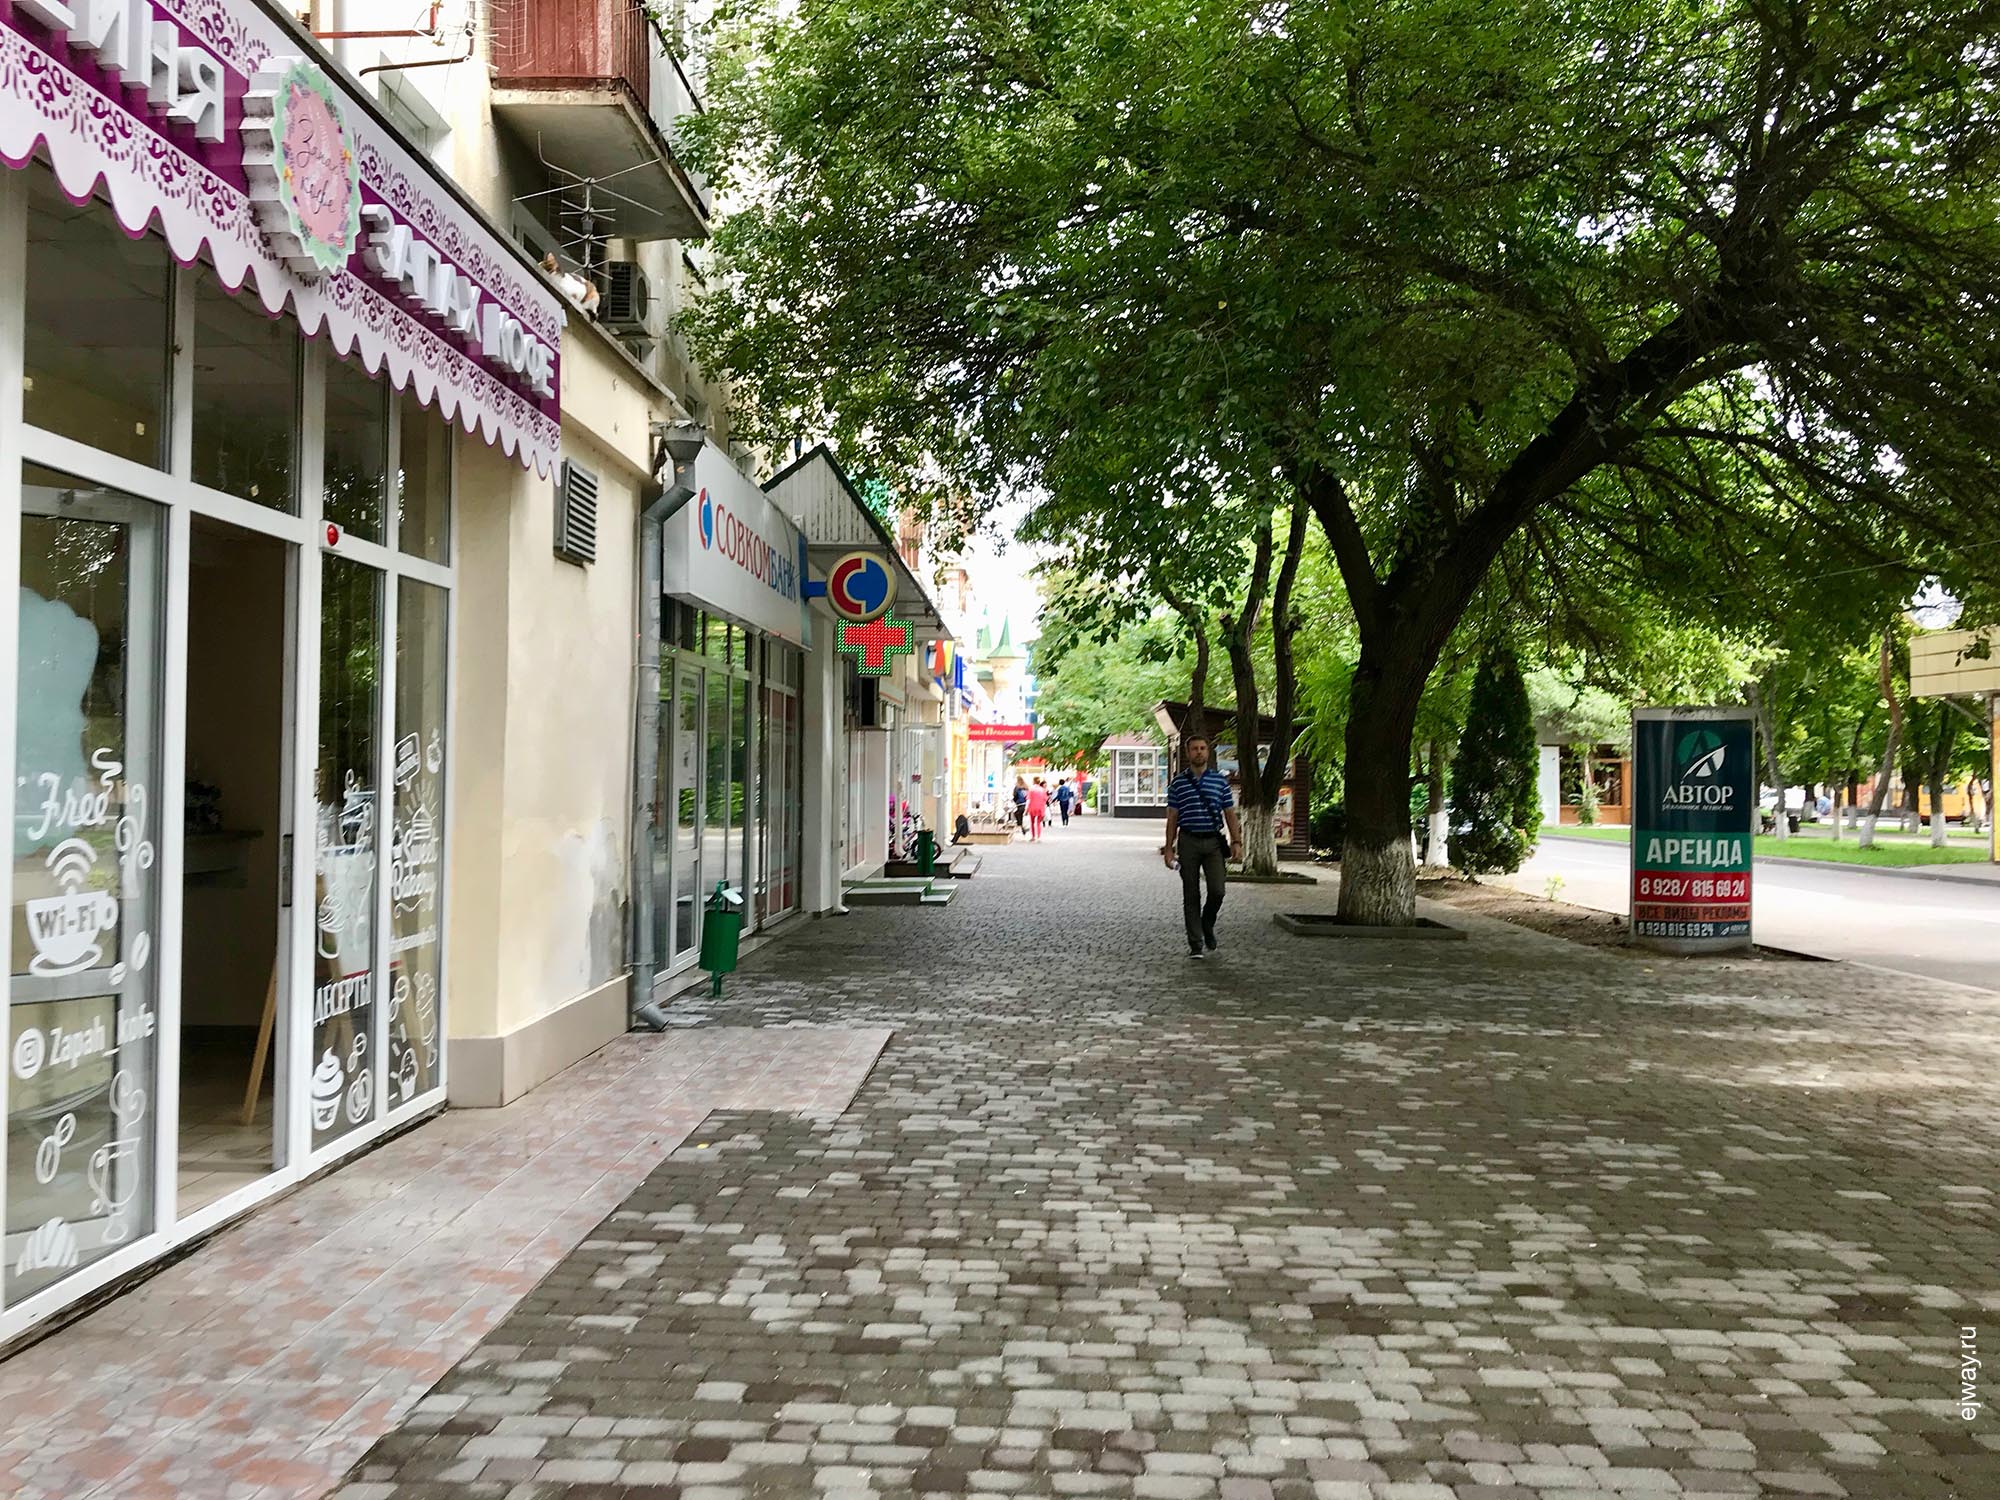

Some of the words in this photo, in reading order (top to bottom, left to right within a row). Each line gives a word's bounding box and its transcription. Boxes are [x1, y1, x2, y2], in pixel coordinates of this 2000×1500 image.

[361, 204, 482, 343] ЗАПАХ
[483, 303, 555, 399] КОФЕ
[715, 503, 797, 603] СОВКОМБАНК
[27, 772, 119, 841] Free
[1662, 784, 1734, 804] АВТОР
[1646, 837, 1743, 868] АРЕНДА
[1640, 877, 1650, 895] 8
[1692, 879, 1714, 897] 815
[1716, 879, 1731, 897] 69
[1732, 879, 1745, 897] 24
[34, 900, 97, 940] Wi-Fi
[1639, 904, 1662, 919] ВСЕ
[1664, 904, 1698, 919] ВИДЫ
[1702, 904, 1748, 918] РЕКЛАМЫ
[314, 972, 372, 1027] ДЕСЕРТЫ
[49, 1003, 156, 1068] Zapah_kofe
